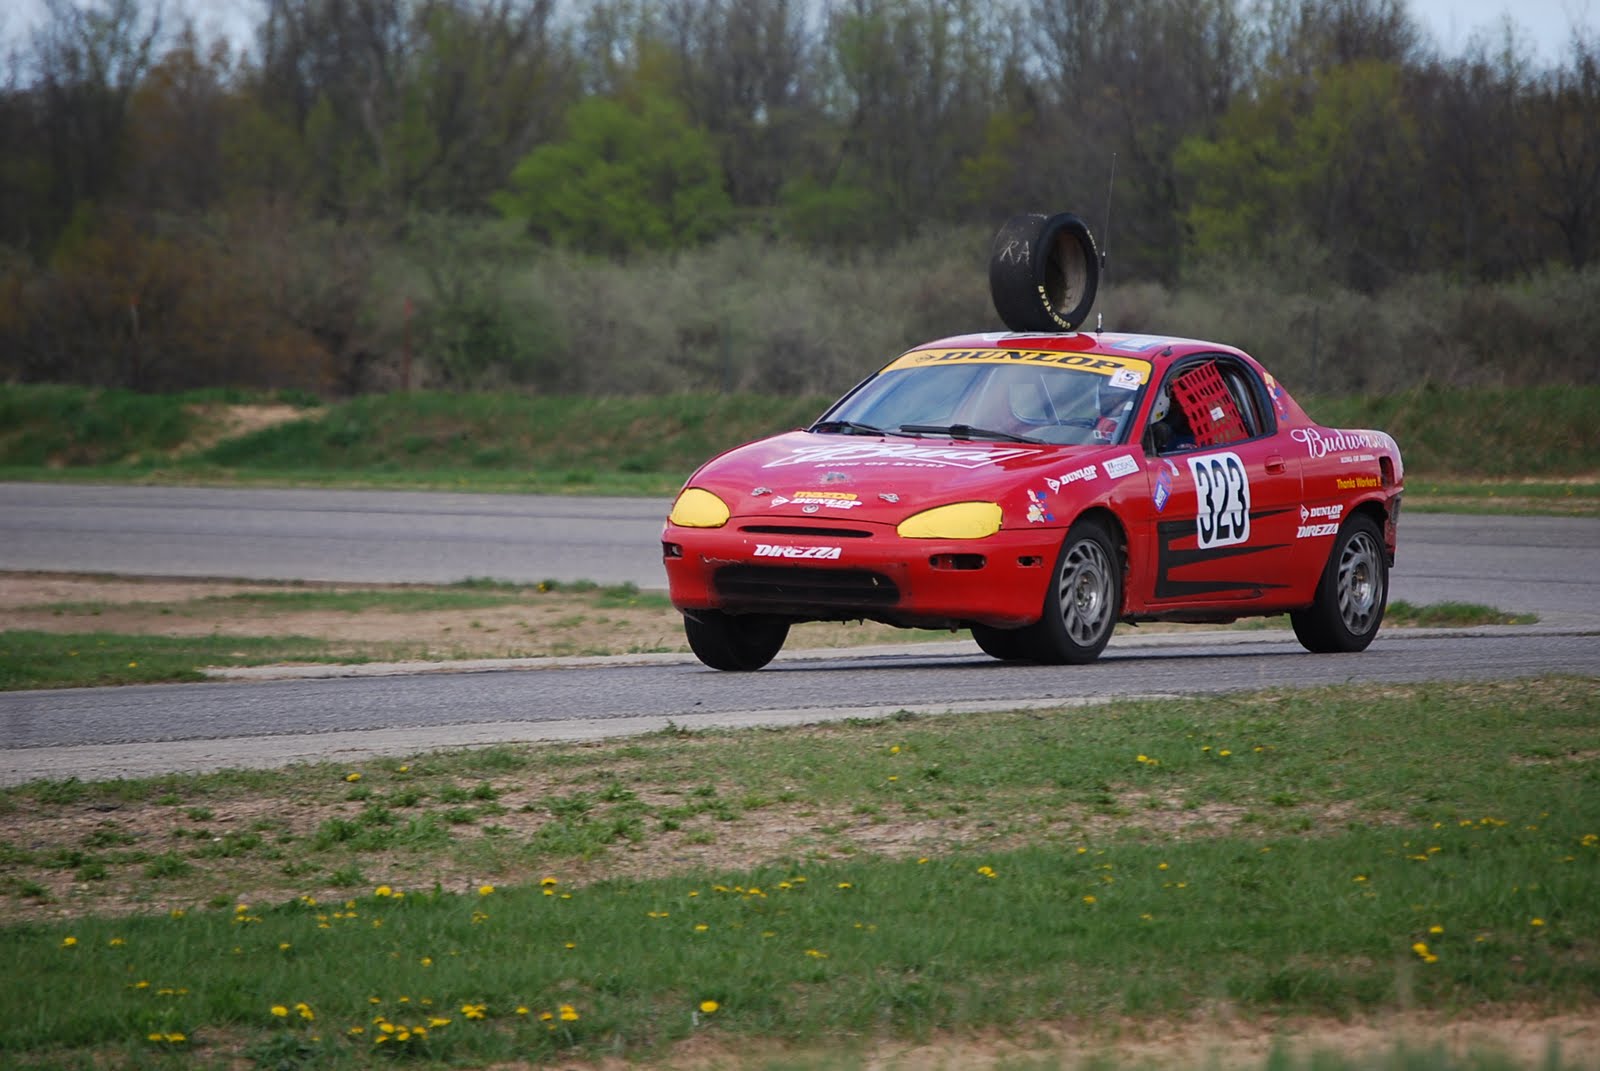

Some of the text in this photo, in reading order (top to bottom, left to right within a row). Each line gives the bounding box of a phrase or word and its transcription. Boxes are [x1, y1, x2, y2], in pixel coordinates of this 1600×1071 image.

[934, 350, 1125, 369] DUNLOP
[1290, 427, 1392, 459] Budweiser
[1060, 465, 1097, 485] DUNLOP
[790, 498, 863, 507] DUNLOP
[1196, 457, 1246, 544] 323
[1310, 504, 1344, 517] DUNLOP
[1296, 522, 1339, 538] DIREZZA
[753, 544, 842, 559] DIREZZA
